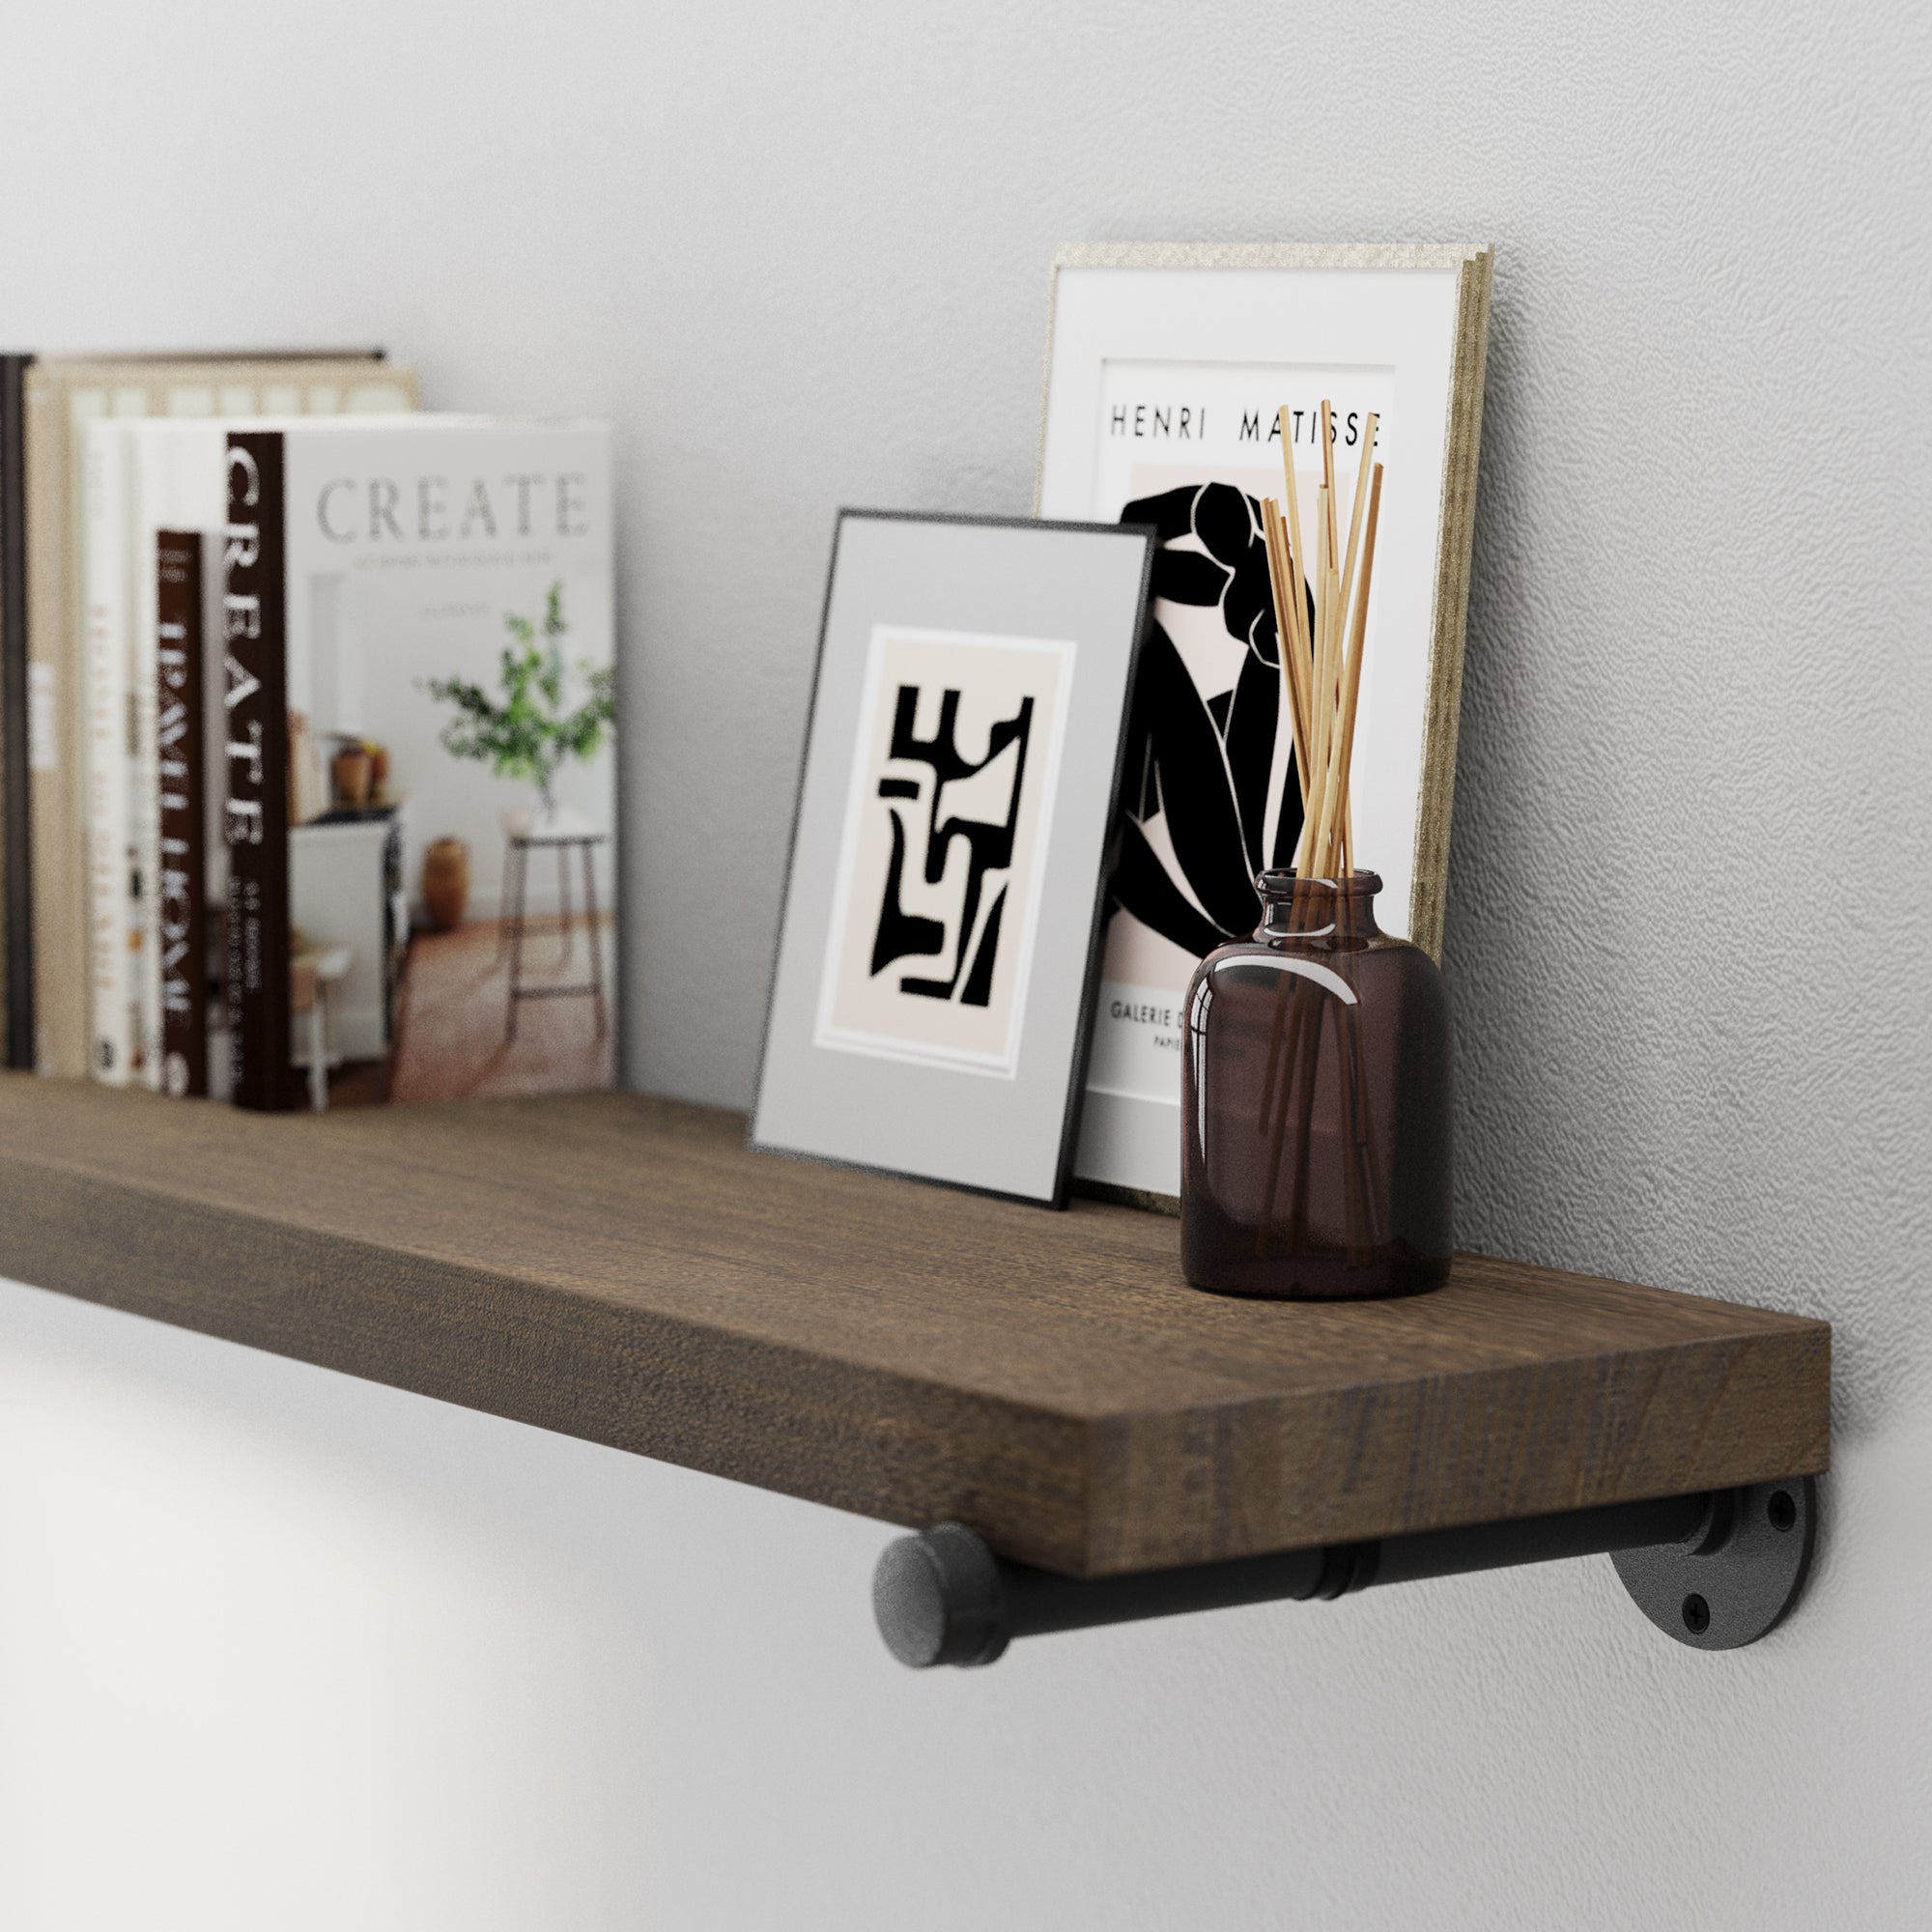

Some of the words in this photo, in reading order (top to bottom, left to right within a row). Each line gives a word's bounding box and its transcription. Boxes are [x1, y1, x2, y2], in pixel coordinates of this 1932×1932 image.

[1111, 404, 1206, 440] HENRI
[316, 470, 589, 545] CREATE
[223, 445, 264, 847] CREATE
[1111, 1000, 1171, 1027] GALERIE
